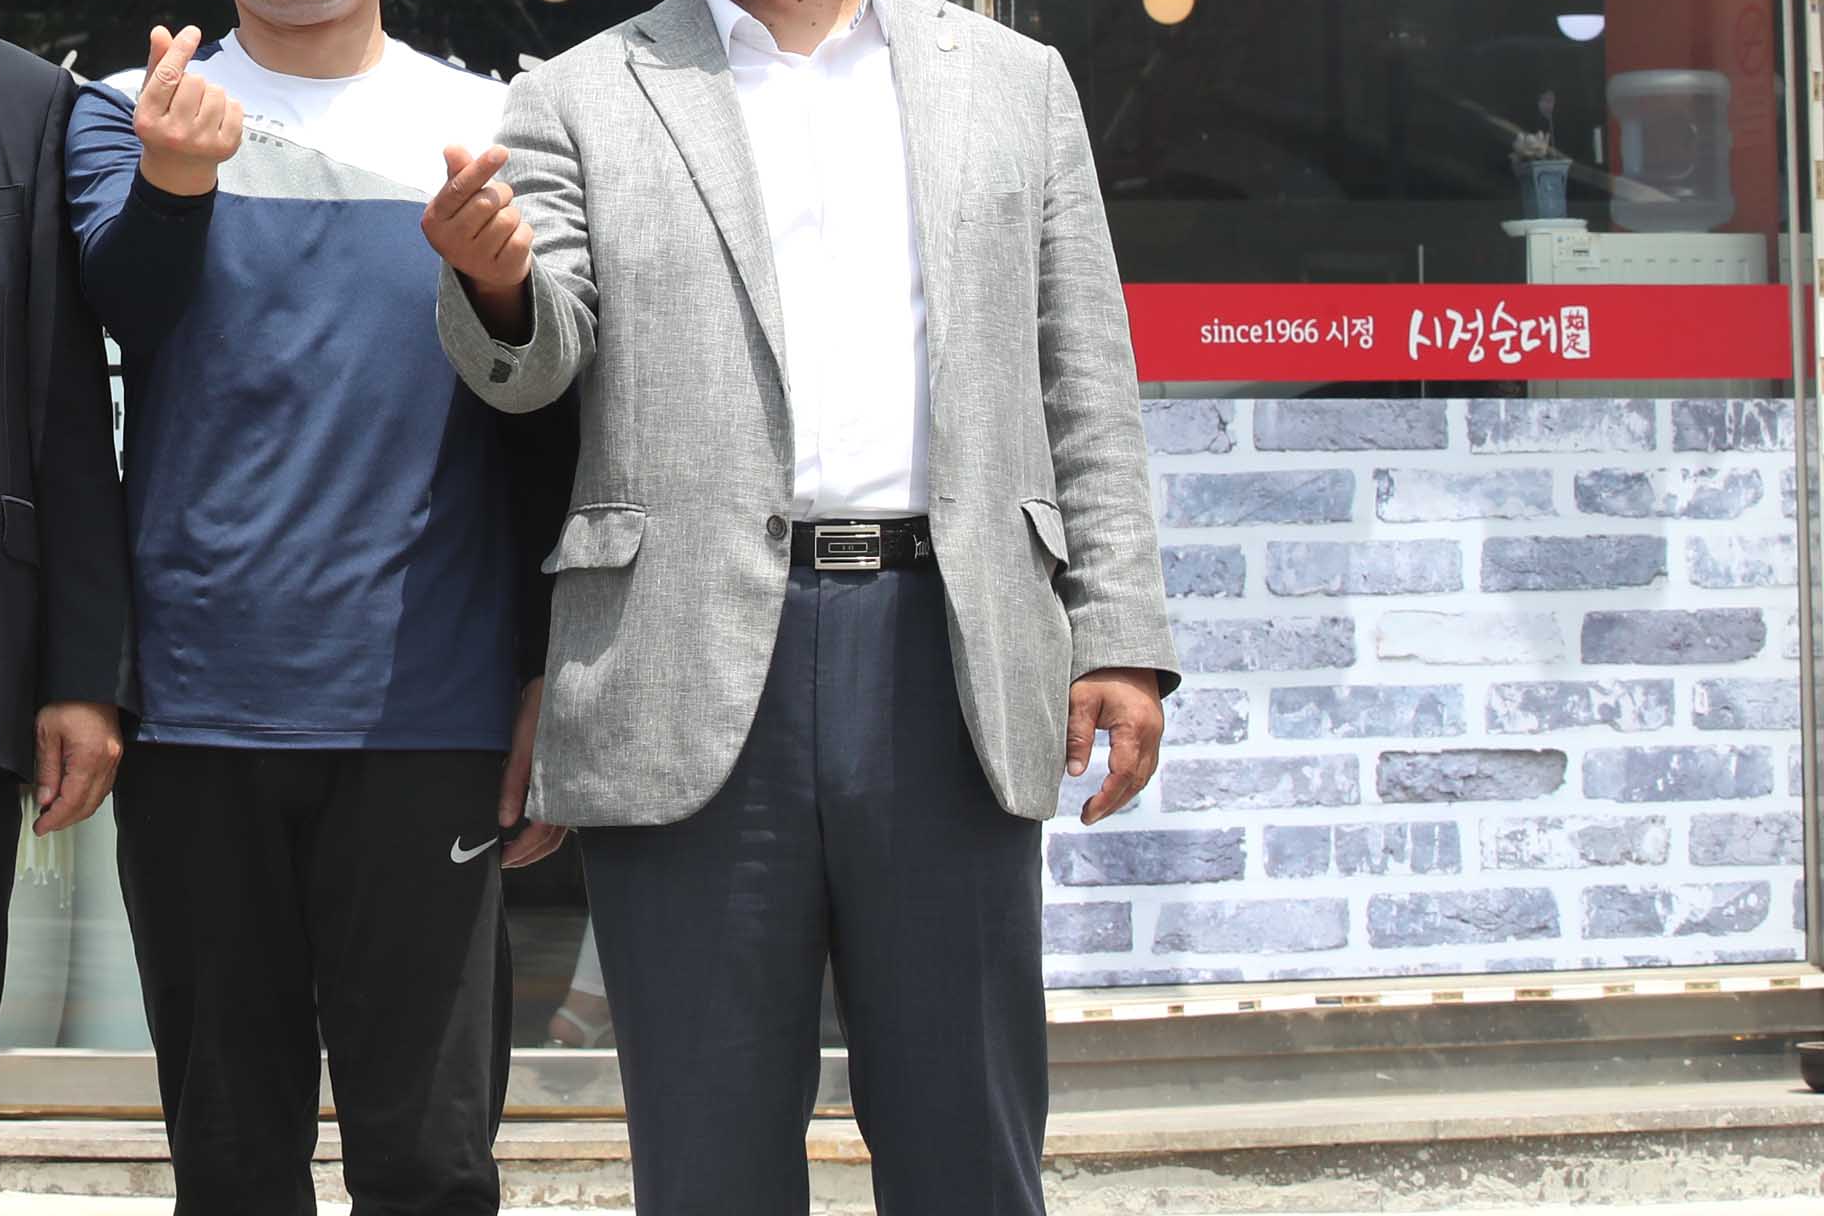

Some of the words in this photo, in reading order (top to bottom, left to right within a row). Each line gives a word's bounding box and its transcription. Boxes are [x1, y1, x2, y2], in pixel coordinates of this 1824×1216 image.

[1200, 318, 1318, 344] since1966
[1326, 316, 1374, 350] 시정
[1408, 300, 1557, 363] 시정순대
